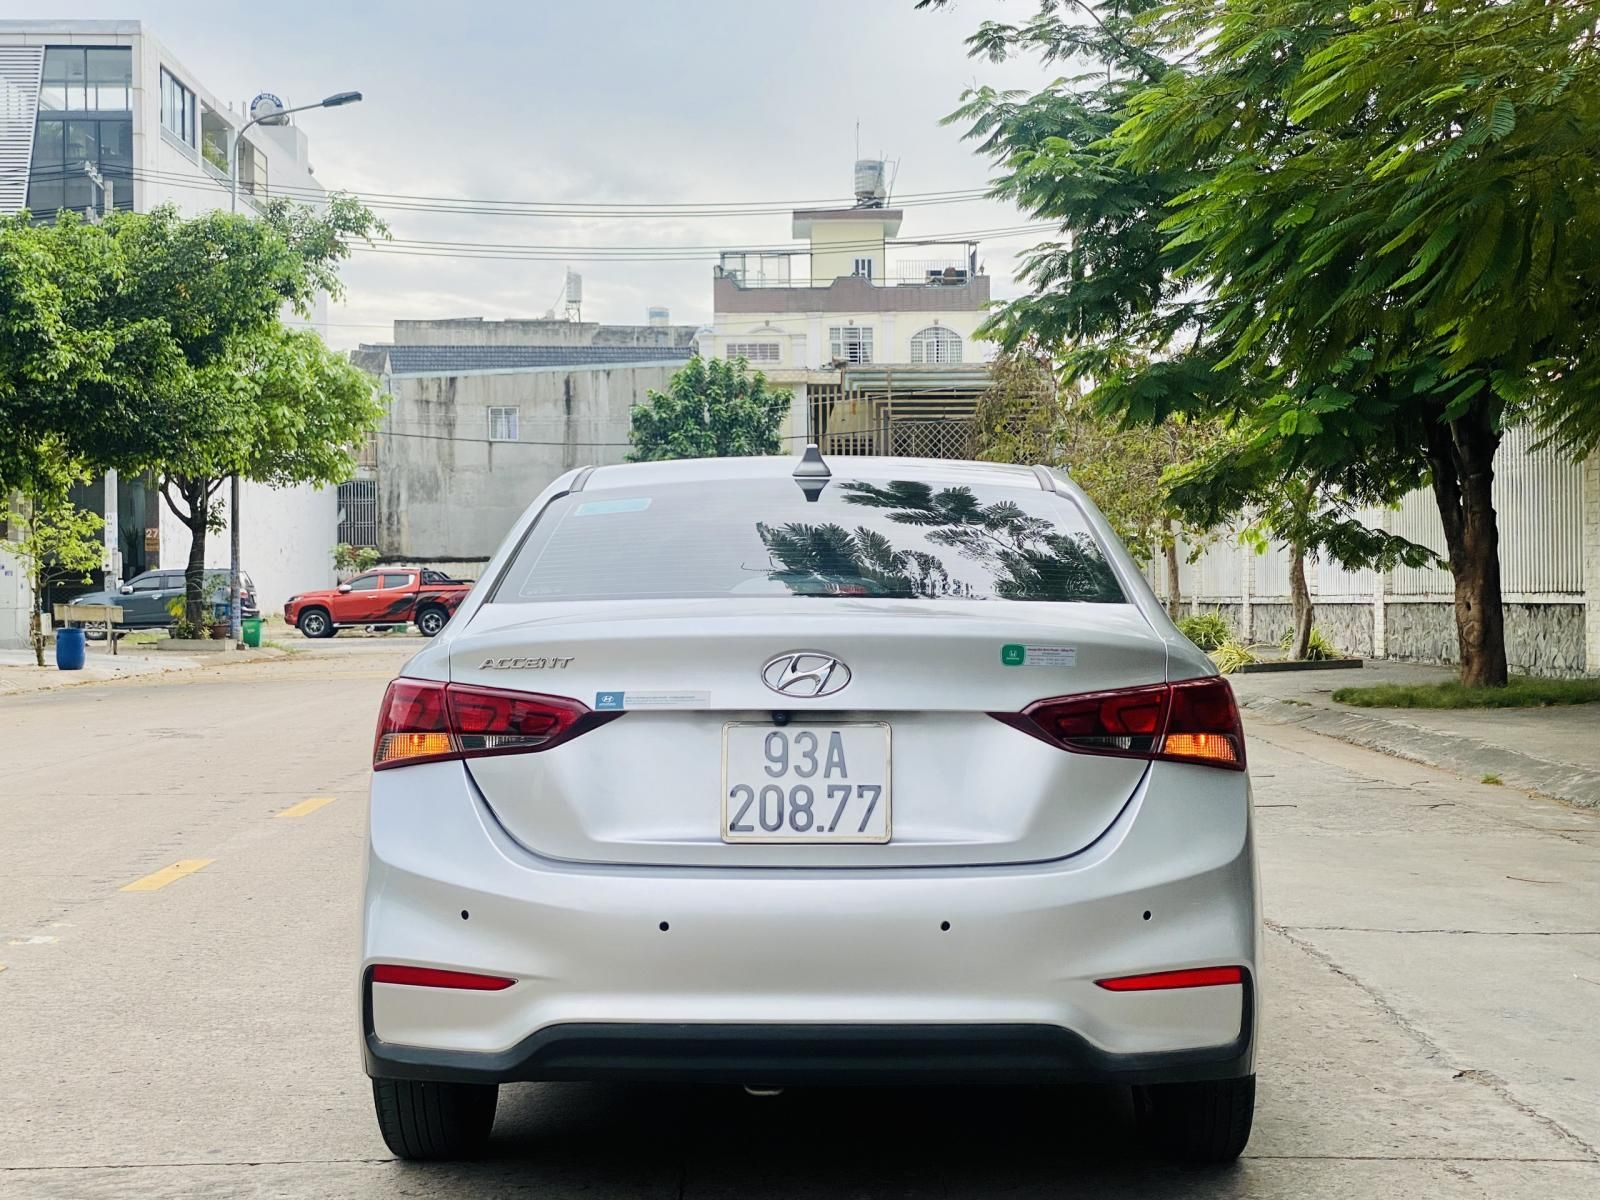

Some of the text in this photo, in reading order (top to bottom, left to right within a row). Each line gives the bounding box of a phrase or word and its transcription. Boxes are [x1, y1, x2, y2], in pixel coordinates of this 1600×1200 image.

[146, 528, 159, 538] 27
[478, 656, 575, 670] ACCENT
[763, 730, 848, 779] 93A
[729, 783, 882, 833] 208.77
